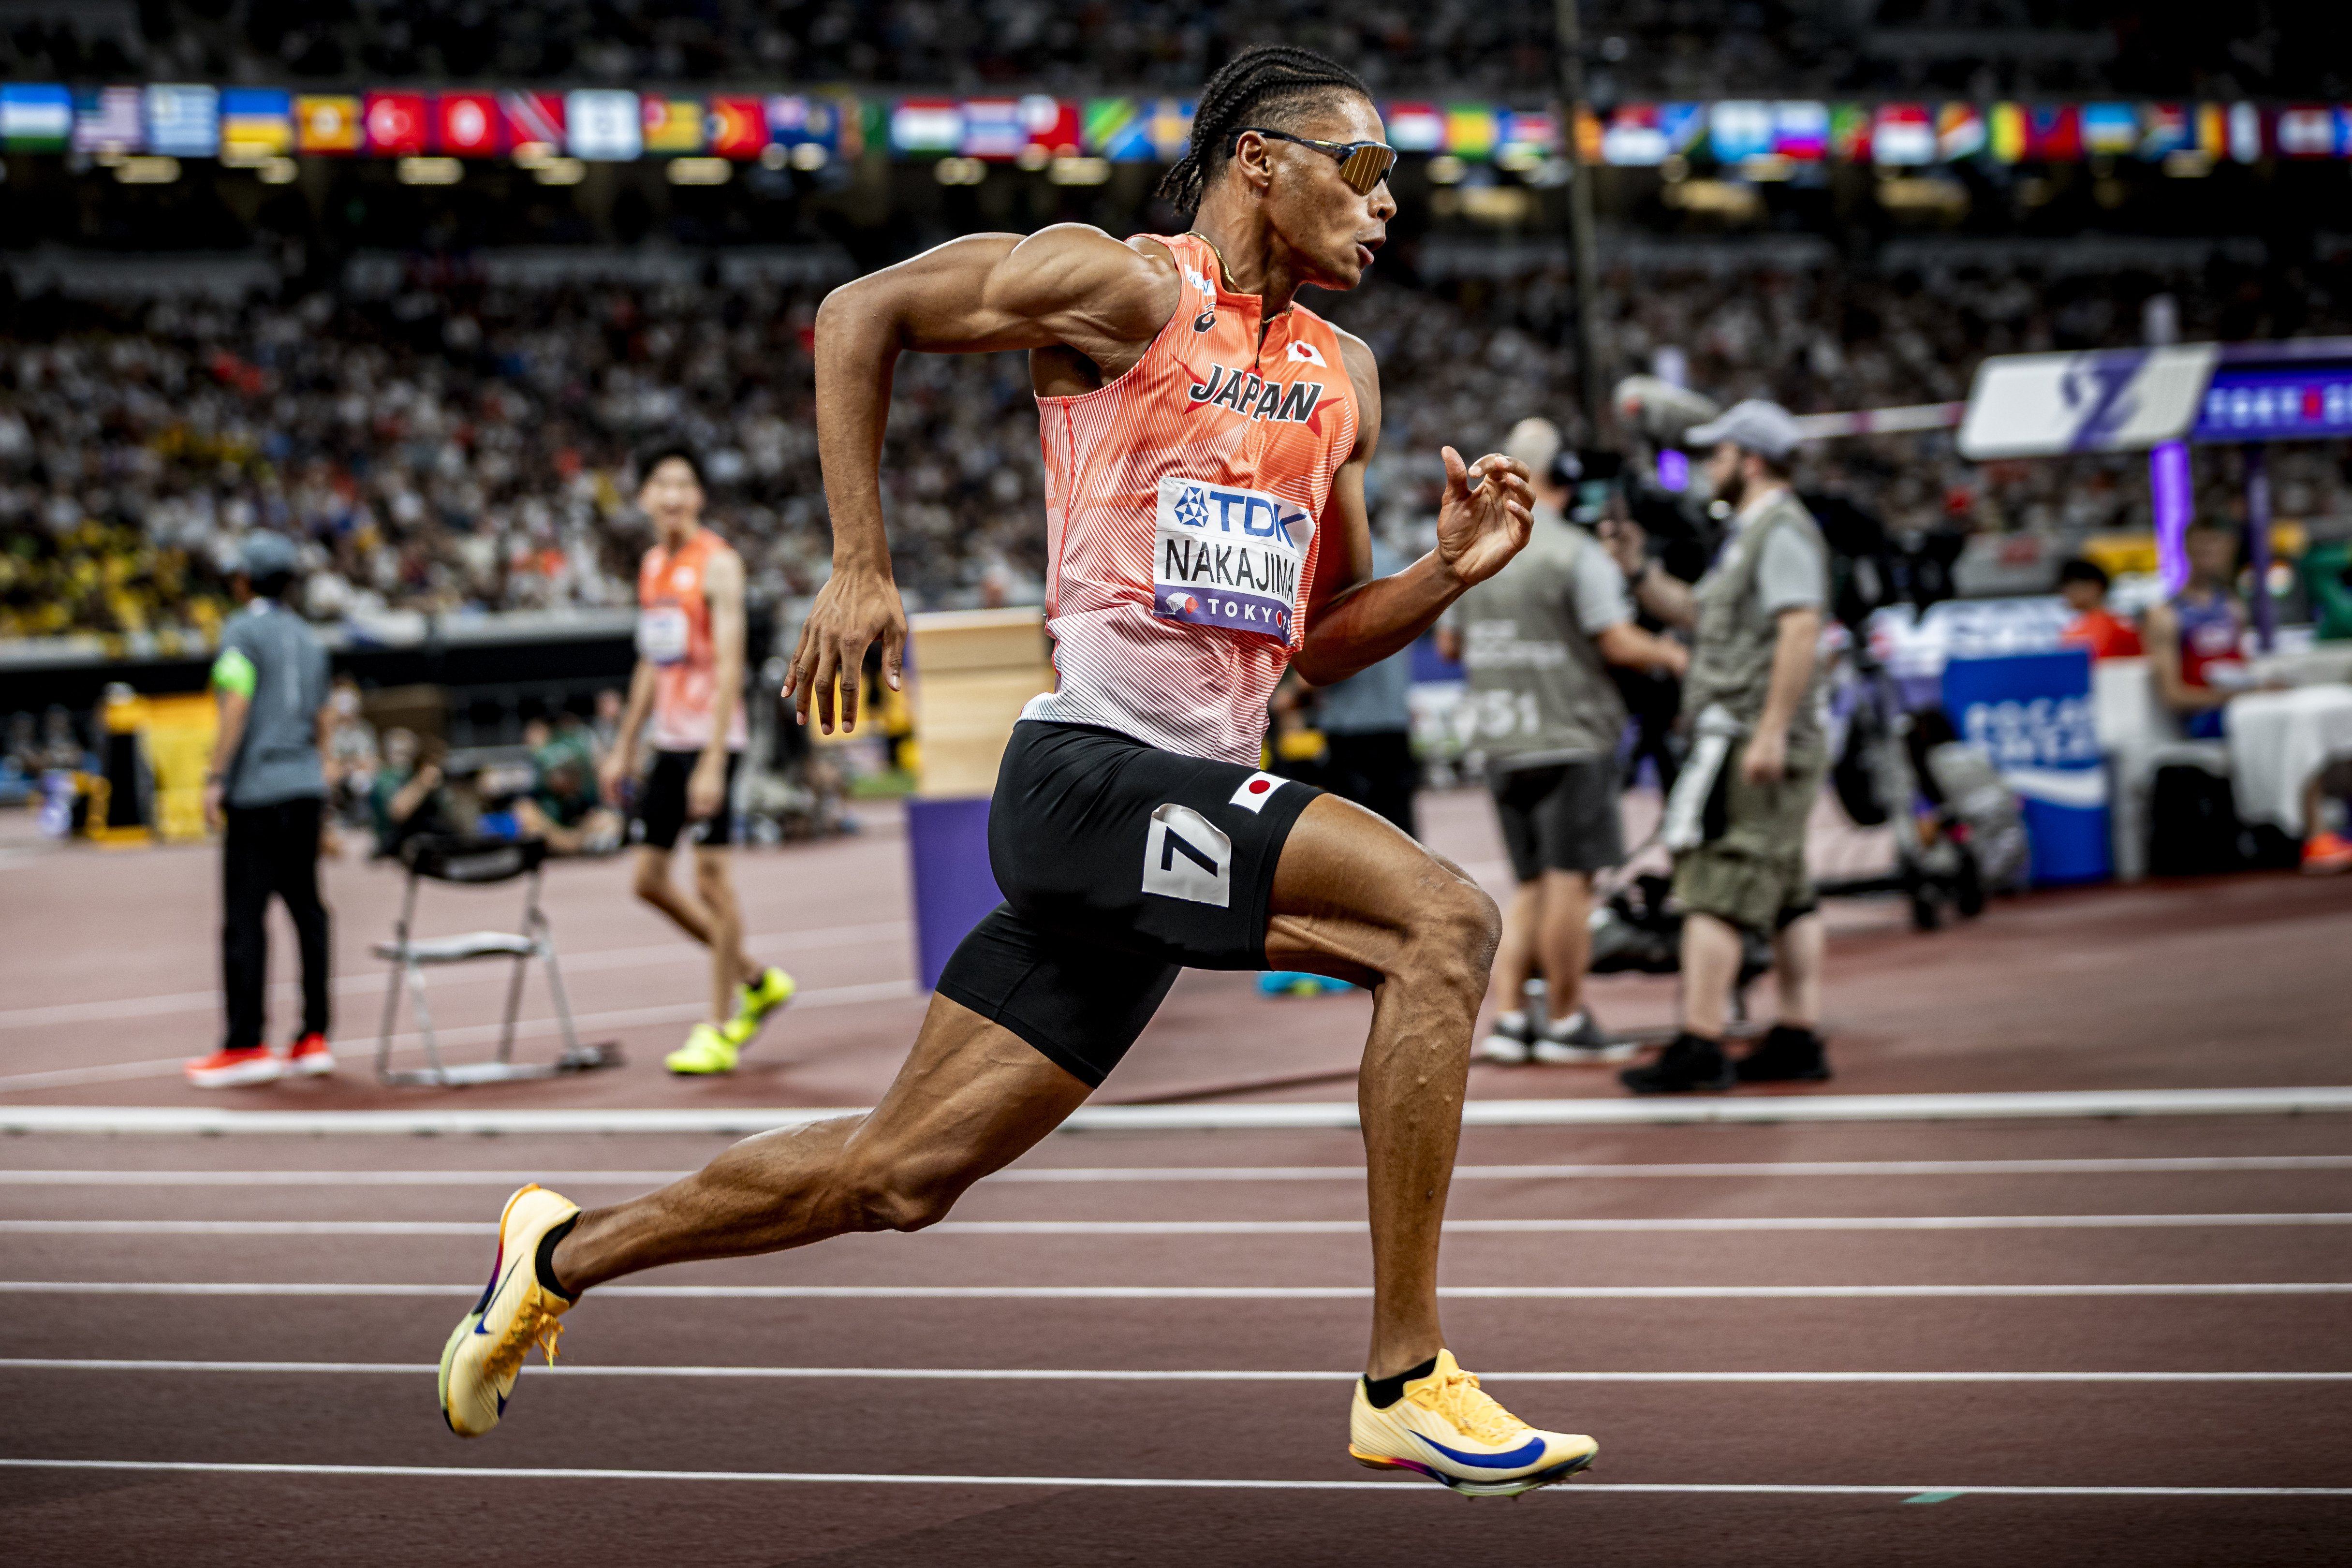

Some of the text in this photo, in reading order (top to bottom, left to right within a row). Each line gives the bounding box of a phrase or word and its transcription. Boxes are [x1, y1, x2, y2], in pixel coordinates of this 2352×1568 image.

[1189, 363, 1323, 423] JAPAN
[1209, 491, 1307, 549] TDK
[1165, 539, 1294, 604] NAKAJIMA
[1161, 825, 1218, 878] 7
